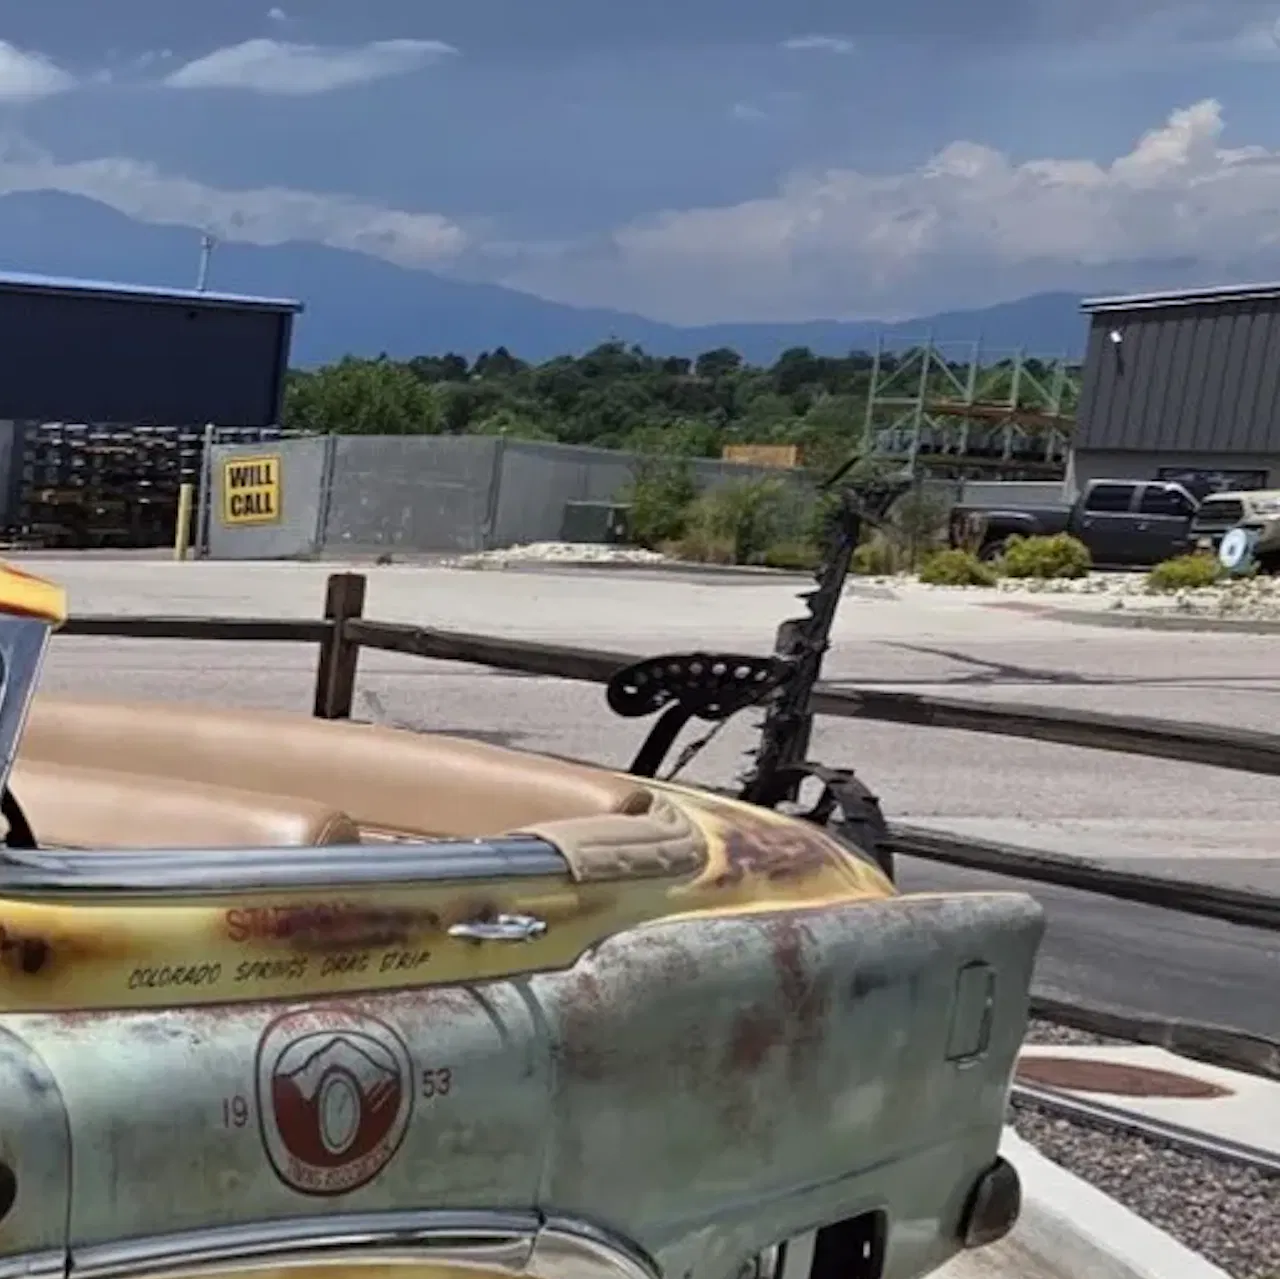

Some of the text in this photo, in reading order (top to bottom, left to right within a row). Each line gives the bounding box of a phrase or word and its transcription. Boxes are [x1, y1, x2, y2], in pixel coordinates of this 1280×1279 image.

[230, 464, 273, 488] WILL
[231, 492, 273, 516] CALL
[127, 962, 222, 990] COLORADO
[222, 1067, 453, 1128] 19 53
